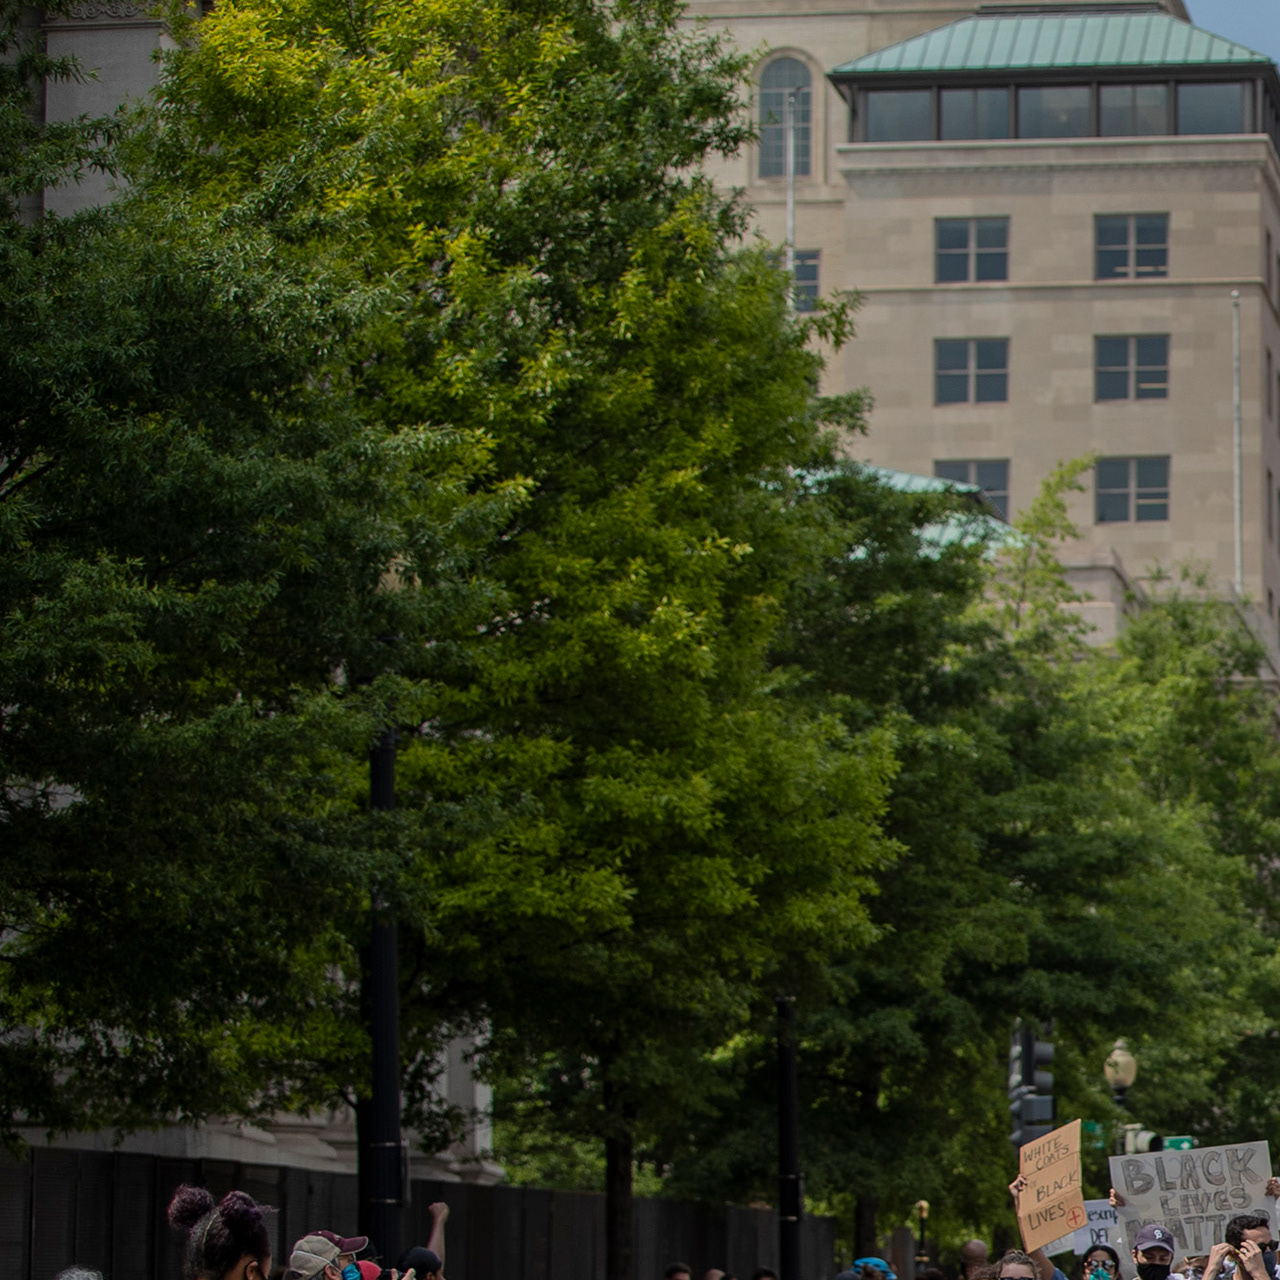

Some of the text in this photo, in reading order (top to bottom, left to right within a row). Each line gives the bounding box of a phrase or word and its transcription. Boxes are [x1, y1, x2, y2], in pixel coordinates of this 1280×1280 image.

[1024, 1135, 1062, 1163] WHITE
[1036, 1145, 1069, 1170] COATS
[1036, 1170, 1078, 1202] BLACK
[1121, 1149, 1263, 1196] BLACK
[1028, 1202, 1066, 1231] LIVES
[1160, 1187, 1252, 1217] LIVES
